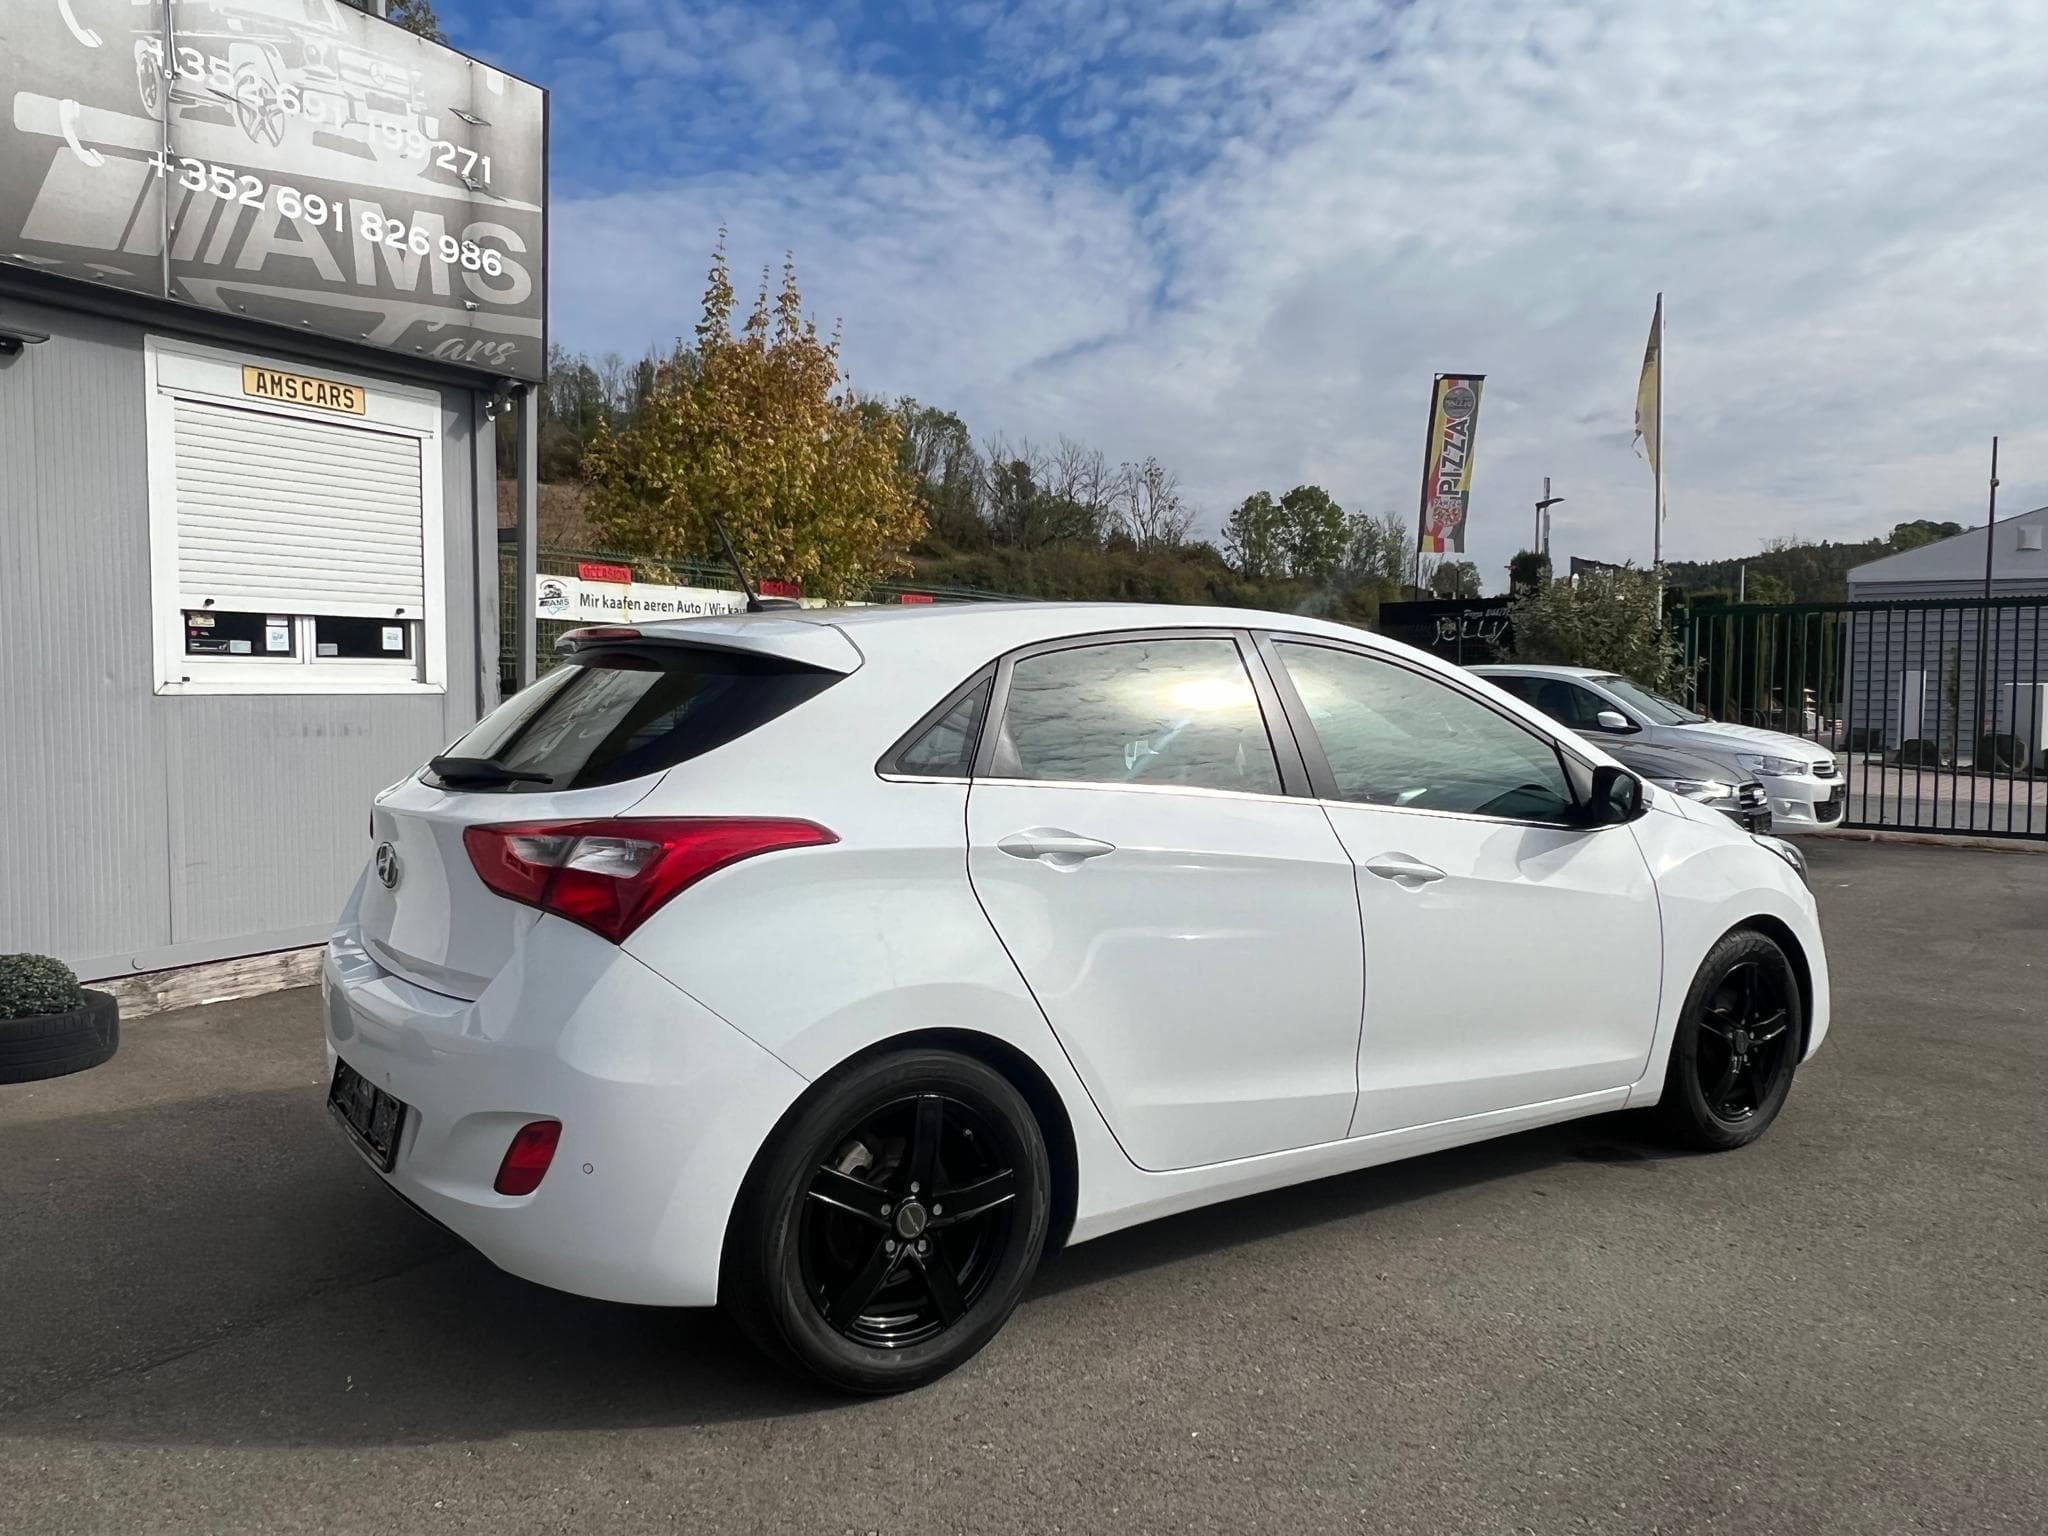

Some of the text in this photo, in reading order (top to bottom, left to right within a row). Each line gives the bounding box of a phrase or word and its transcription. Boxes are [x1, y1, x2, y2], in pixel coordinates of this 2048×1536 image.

[436, 140, 491, 185] 271
[148, 150, 502, 277] +352 691 826 986
[256, 371, 355, 409] AMSCARS
[1437, 417, 1470, 499] PIZZA
[580, 593, 599, 609] Mir
[602, 594, 641, 611] kaafen
[643, 601, 676, 613] aeren
[677, 600, 701, 614] Auto
[709, 602, 725, 615] Wir
